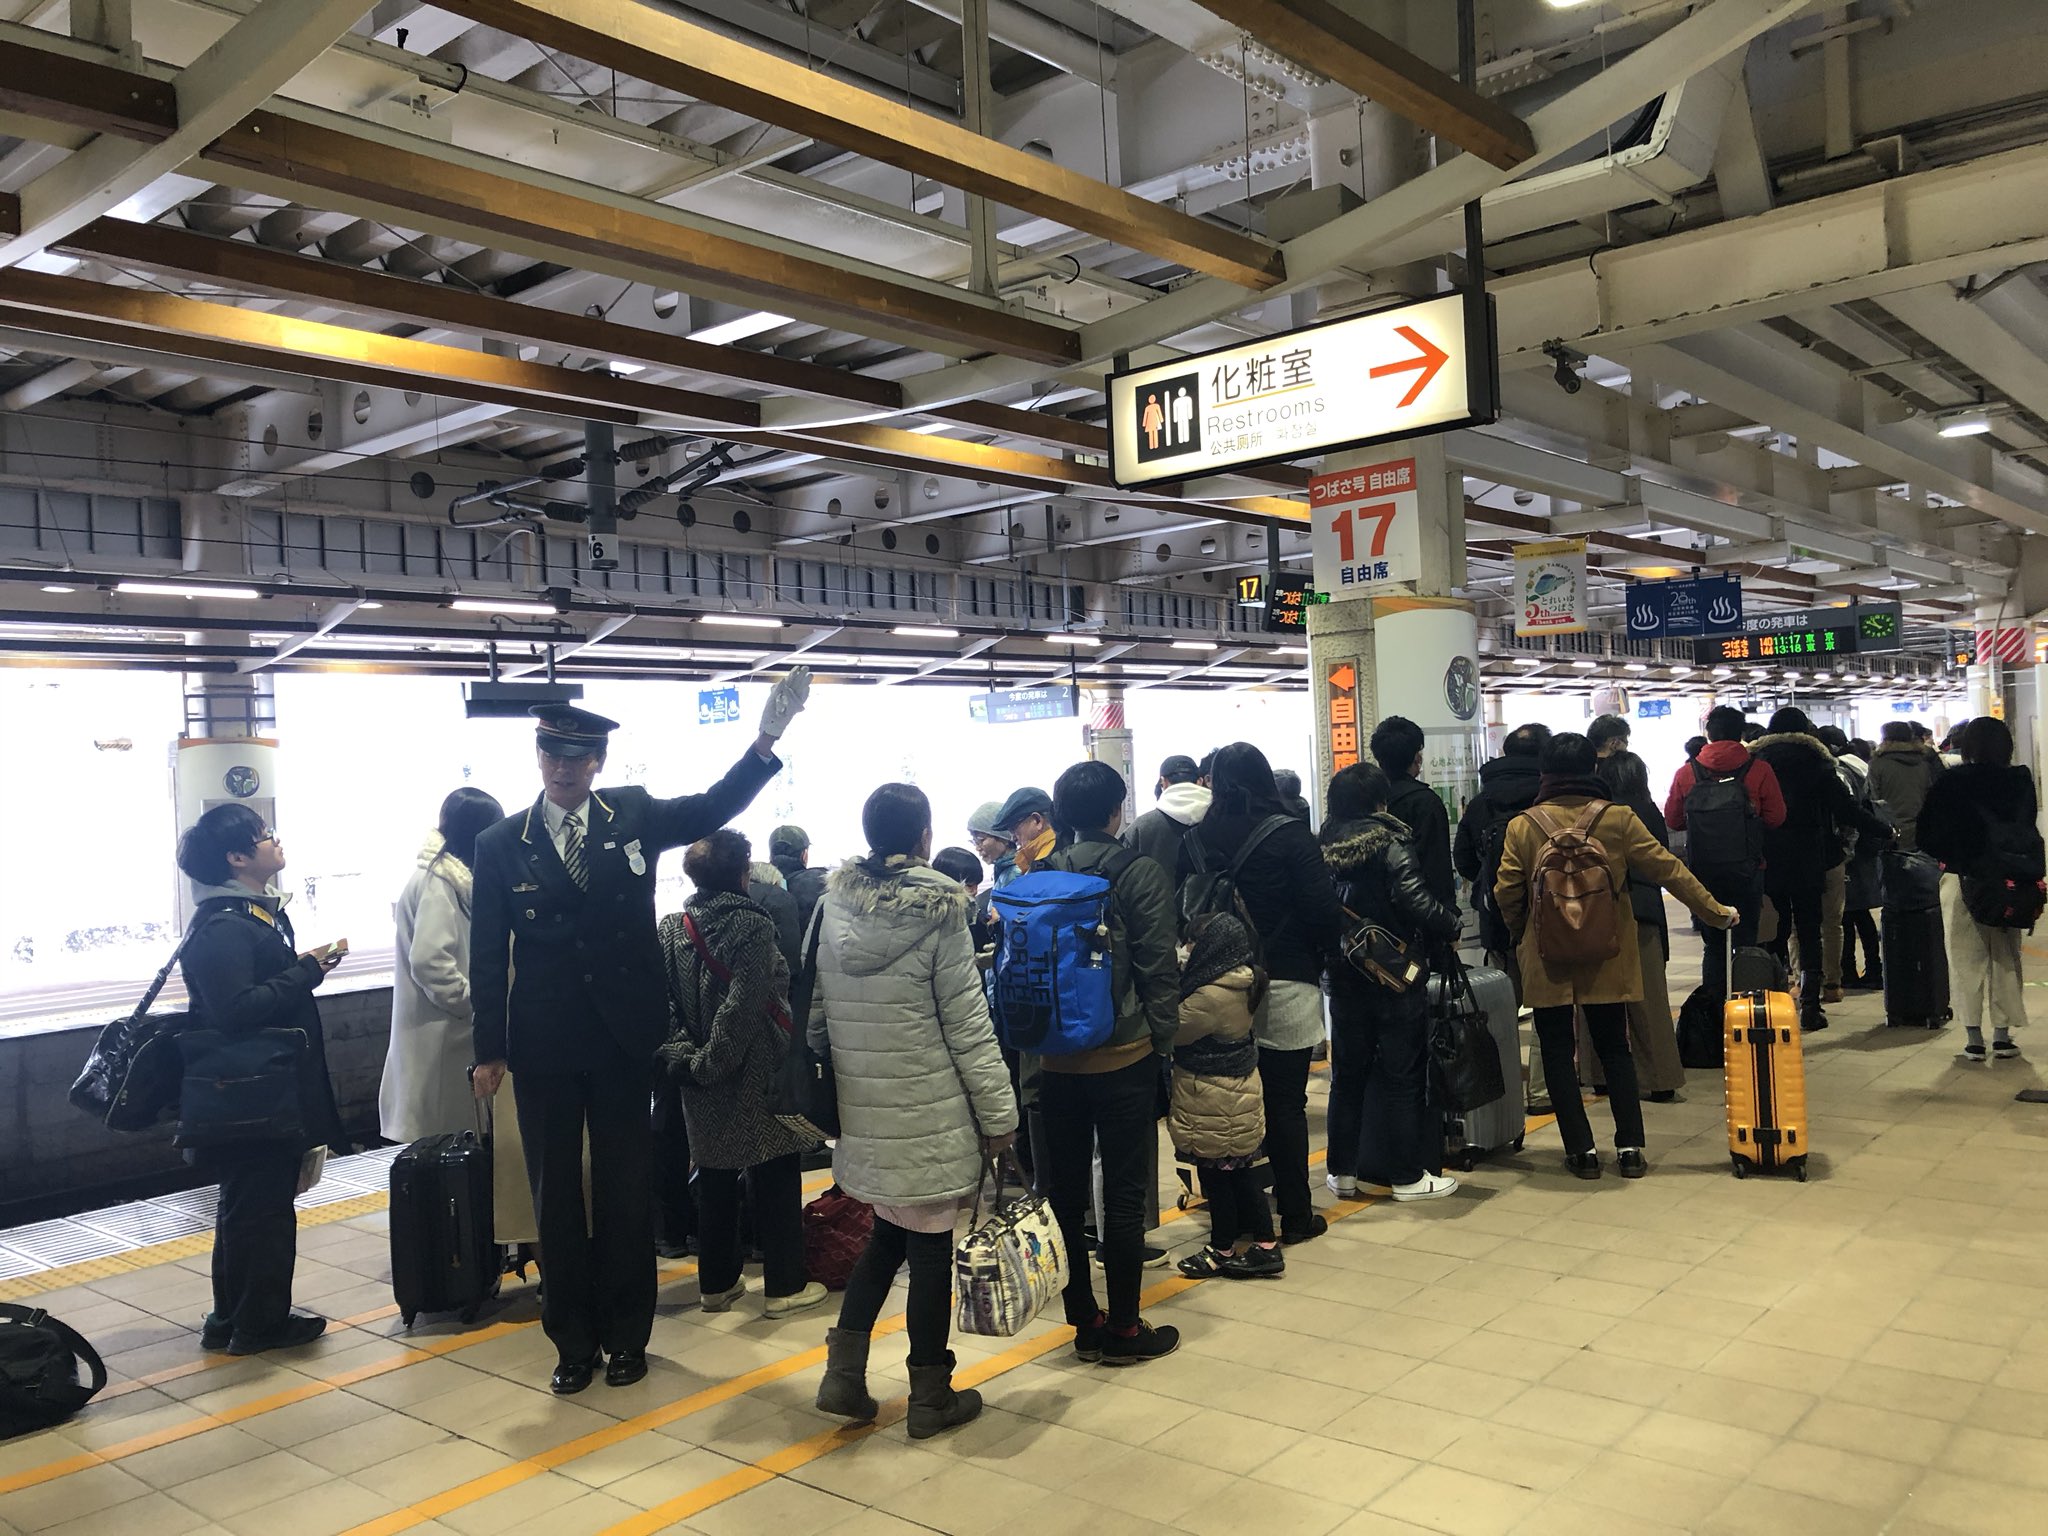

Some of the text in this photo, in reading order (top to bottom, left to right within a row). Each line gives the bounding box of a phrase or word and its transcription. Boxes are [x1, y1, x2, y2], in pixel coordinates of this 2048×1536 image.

[1212, 349, 1313, 403] 化粧室
[1208, 398, 1325, 435] Restrooms
[1313, 467, 1411, 500] つばさ号 自由席
[1331, 502, 1396, 562] 17
[1341, 561, 1389, 585] 自由席
[1239, 577, 1259, 599] 17
[1548, 604, 1575, 612] つばさ
[1743, 615, 1808, 632] 度の発車は
[1721, 639, 1749, 650] つばさ
[1774, 634, 1801, 645] 11:17
[1722, 649, 1749, 658] つばさ
[1774, 644, 1802, 655] 13:18
[1062, 687, 1069, 698] 2
